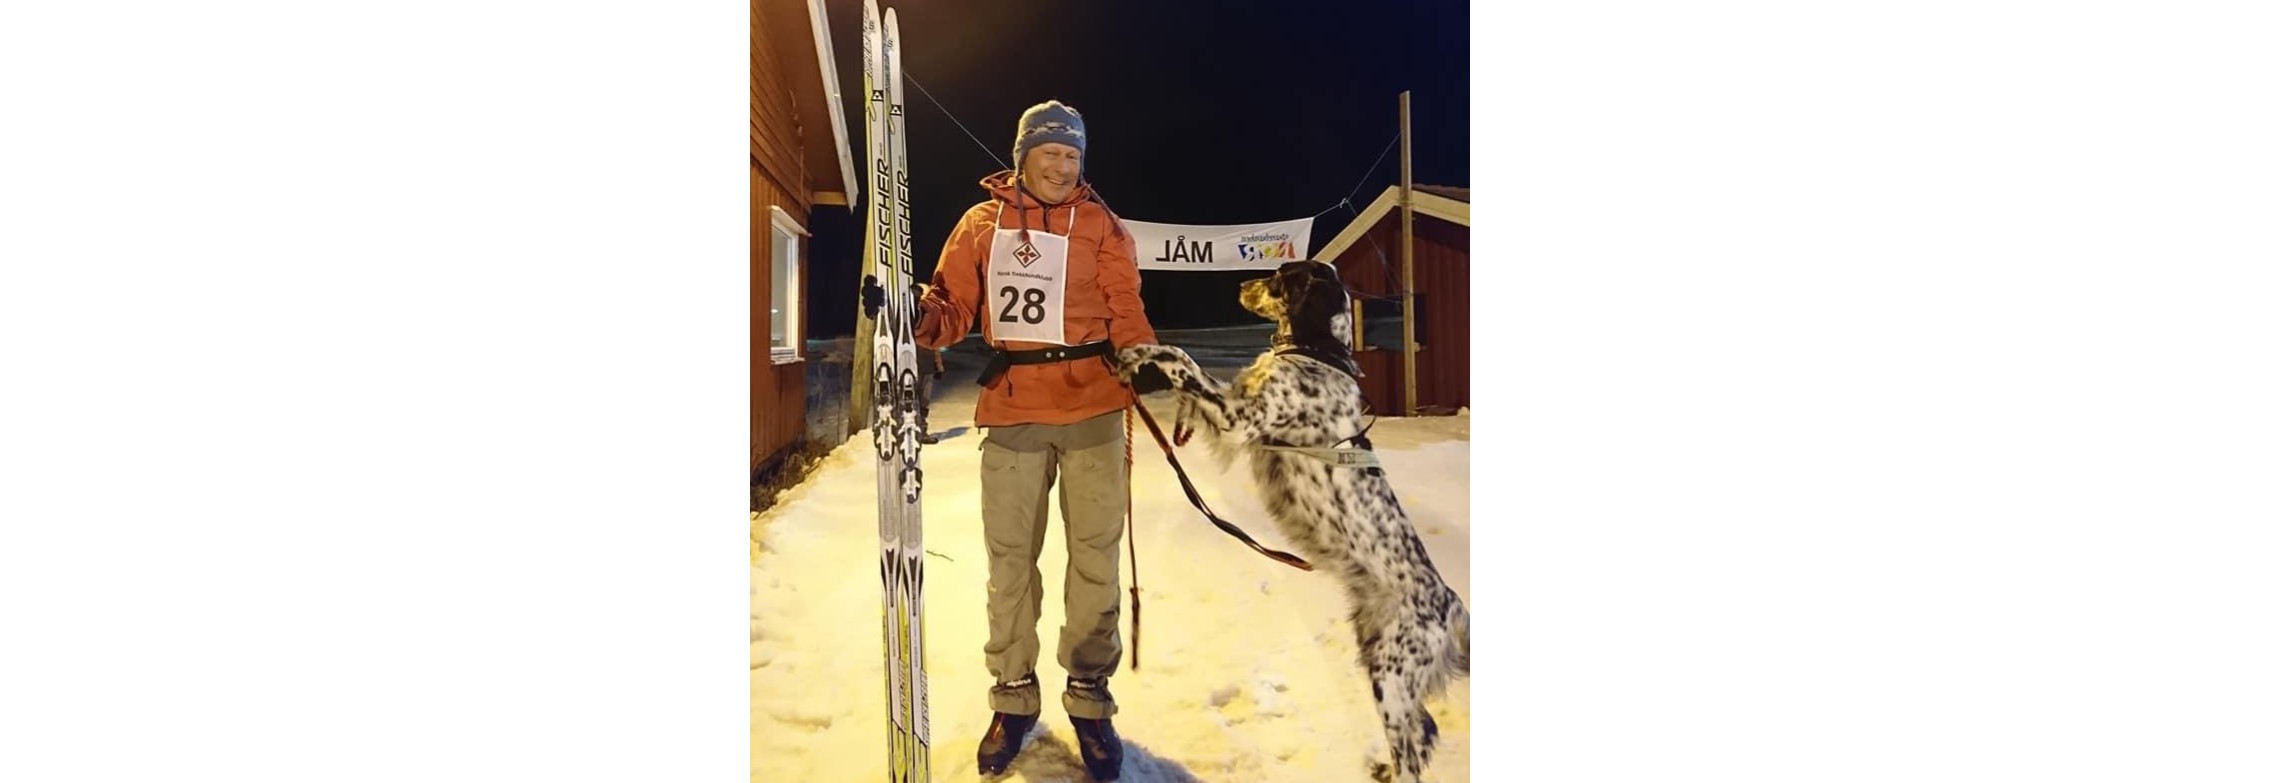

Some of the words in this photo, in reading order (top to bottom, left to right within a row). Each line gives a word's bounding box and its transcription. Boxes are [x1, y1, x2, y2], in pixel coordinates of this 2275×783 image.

[877, 158, 892, 268] FISCHER
[897, 170, 913, 277] FISCHER
[999, 285, 1046, 325] 28
